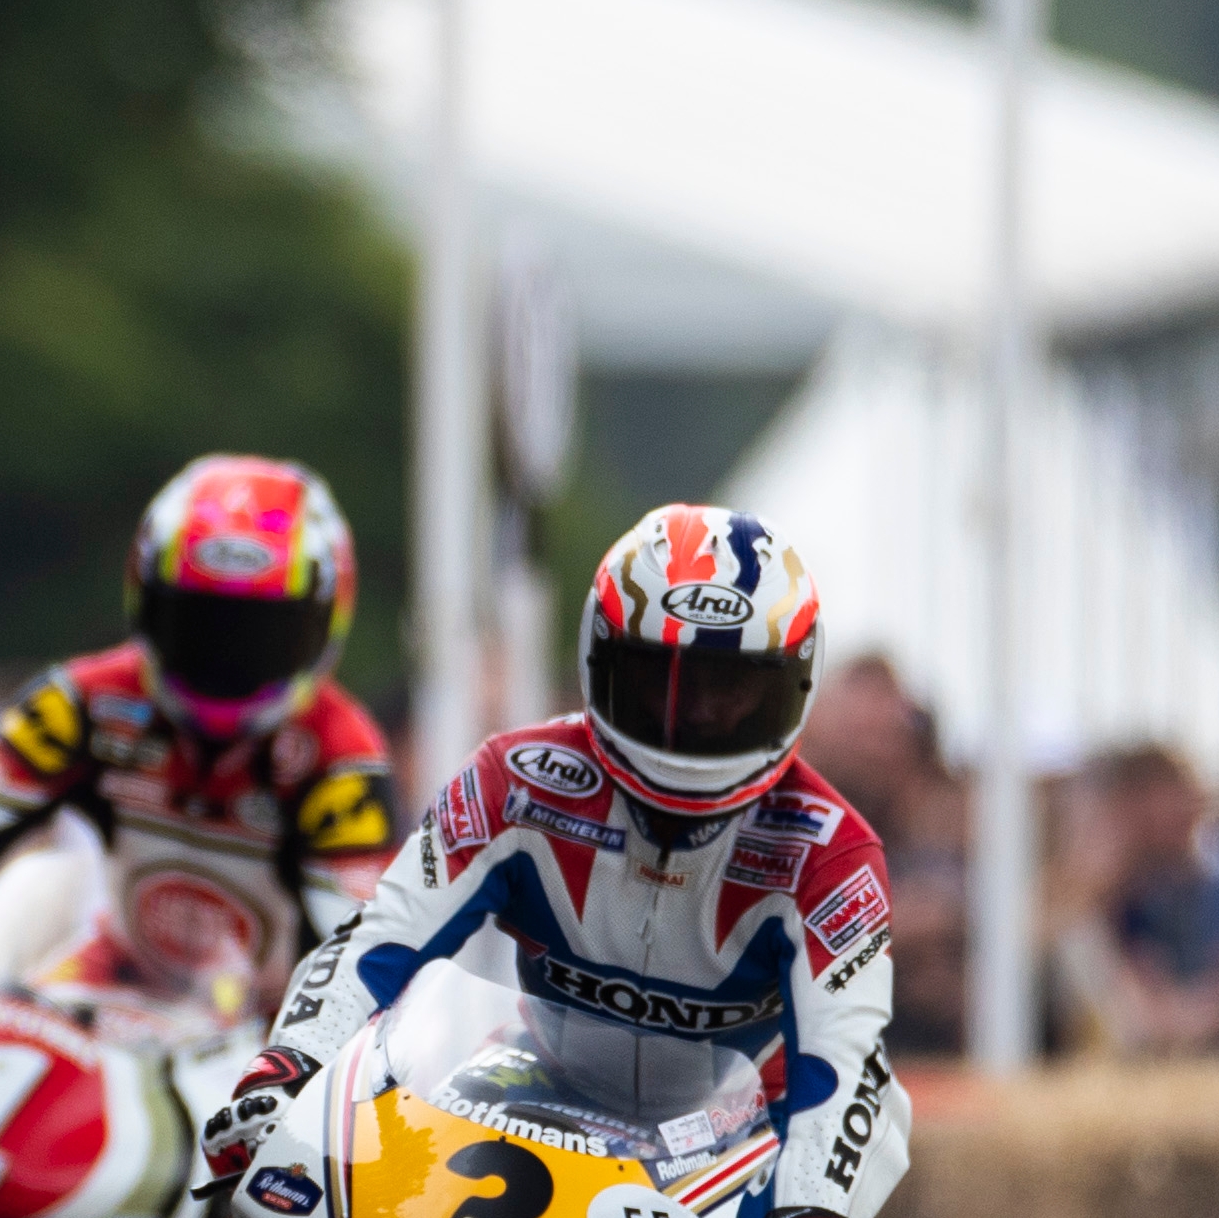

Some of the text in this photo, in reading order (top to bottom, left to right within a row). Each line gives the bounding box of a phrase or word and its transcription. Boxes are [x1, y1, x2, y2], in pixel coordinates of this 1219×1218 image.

[668, 586, 741, 617] Arai
[517, 749, 588, 785] Arai
[530, 807, 623, 846] MICHELIN
[434, 1087, 609, 1158] Rothmans
